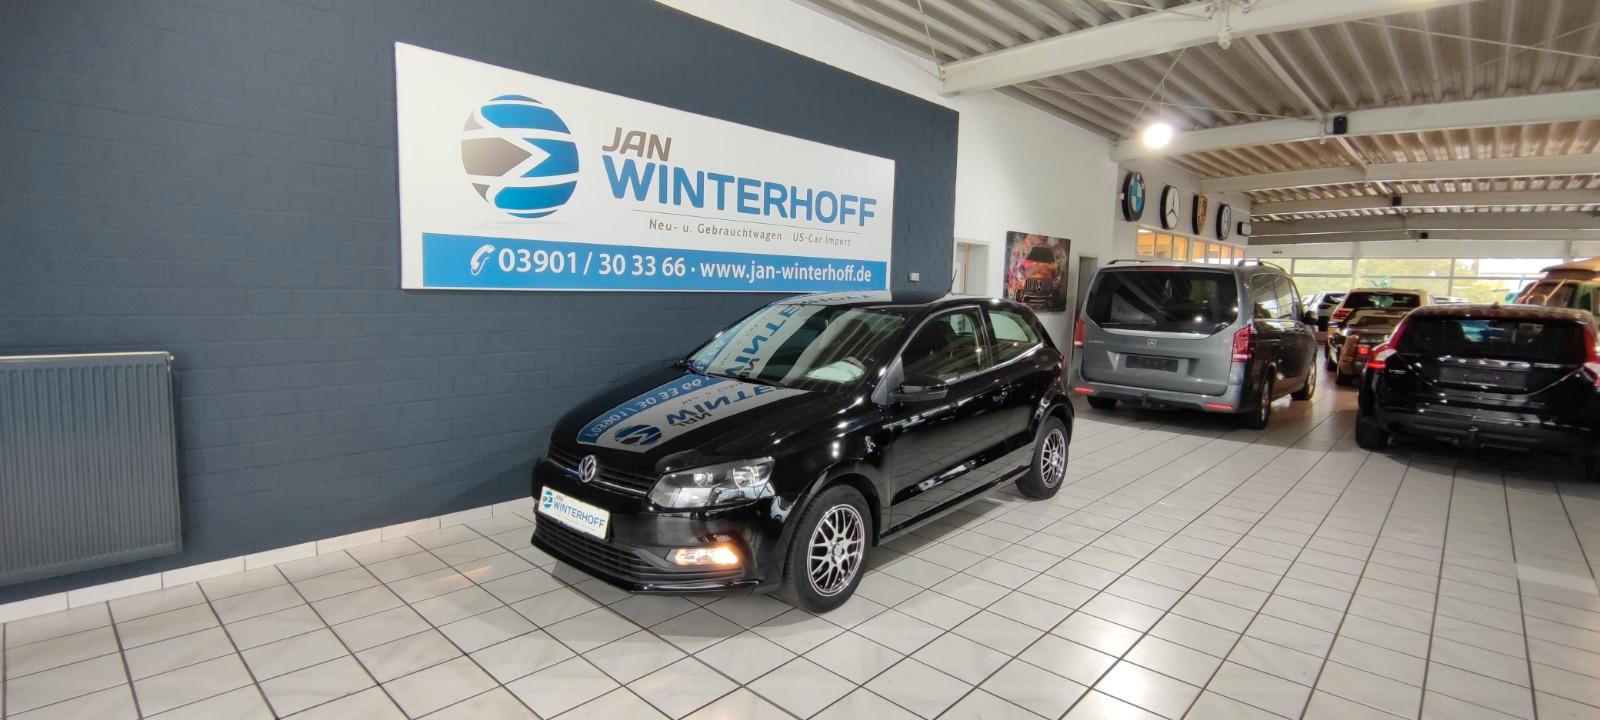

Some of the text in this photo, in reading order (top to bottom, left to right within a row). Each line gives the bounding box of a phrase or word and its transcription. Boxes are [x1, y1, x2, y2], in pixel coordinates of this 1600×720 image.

[602, 127, 672, 162] JAN
[602, 155, 877, 226] WINTERHOFF
[649, 219, 679, 231] Neu-
[697, 223, 783, 242] Gebrauchtwagen
[792, 232, 823, 244] US-Car
[824, 235, 851, 247] Import
[498, 248, 577, 273] 03901
[598, 253, 626, 275] 30
[631, 254, 657, 276] 33
[661, 256, 686, 277] 66
[700, 260, 872, 284] www.jan-winterhoff.de
[553, 501, 606, 529] WINTERHOFF
